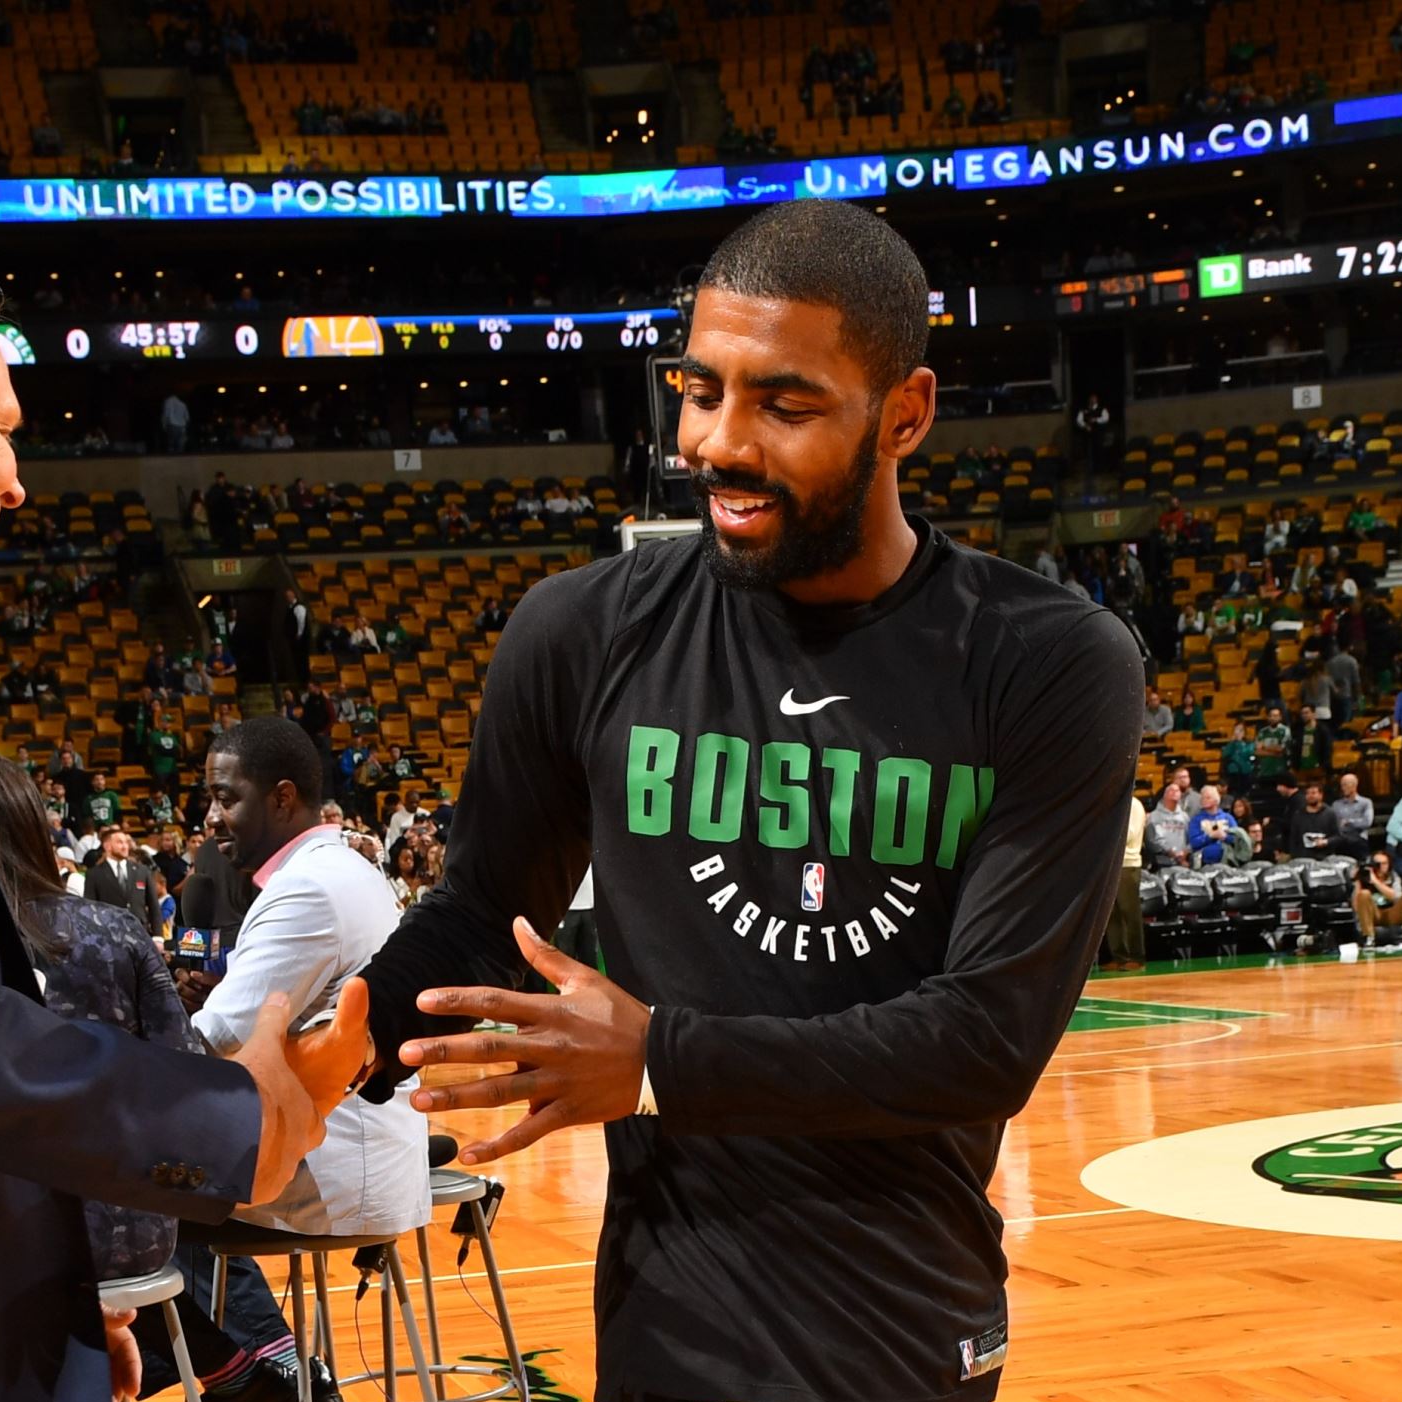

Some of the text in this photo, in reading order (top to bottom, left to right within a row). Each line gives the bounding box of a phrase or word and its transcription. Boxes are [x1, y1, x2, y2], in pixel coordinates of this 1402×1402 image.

[23, 180, 567, 217] UNLIMITED POSSIBILITIES.
[1204, 262, 1239, 289] TD
[1248, 254, 1313, 280] Bank
[401, 326, 659, 350] 7 0 0 0/0 0/0
[479, 319, 513, 333] FG%
[554, 317, 574, 332] FG
[626, 314, 653, 328] 3PT
[66, 322, 258, 359] 0 45:57 0
[143, 345, 186, 359] QTR 1
[1301, 389, 1312, 406] 8
[401, 453, 412, 467] 7
[626, 725, 995, 870] BOSTON
[689, 853, 922, 963] BASKETBALL
